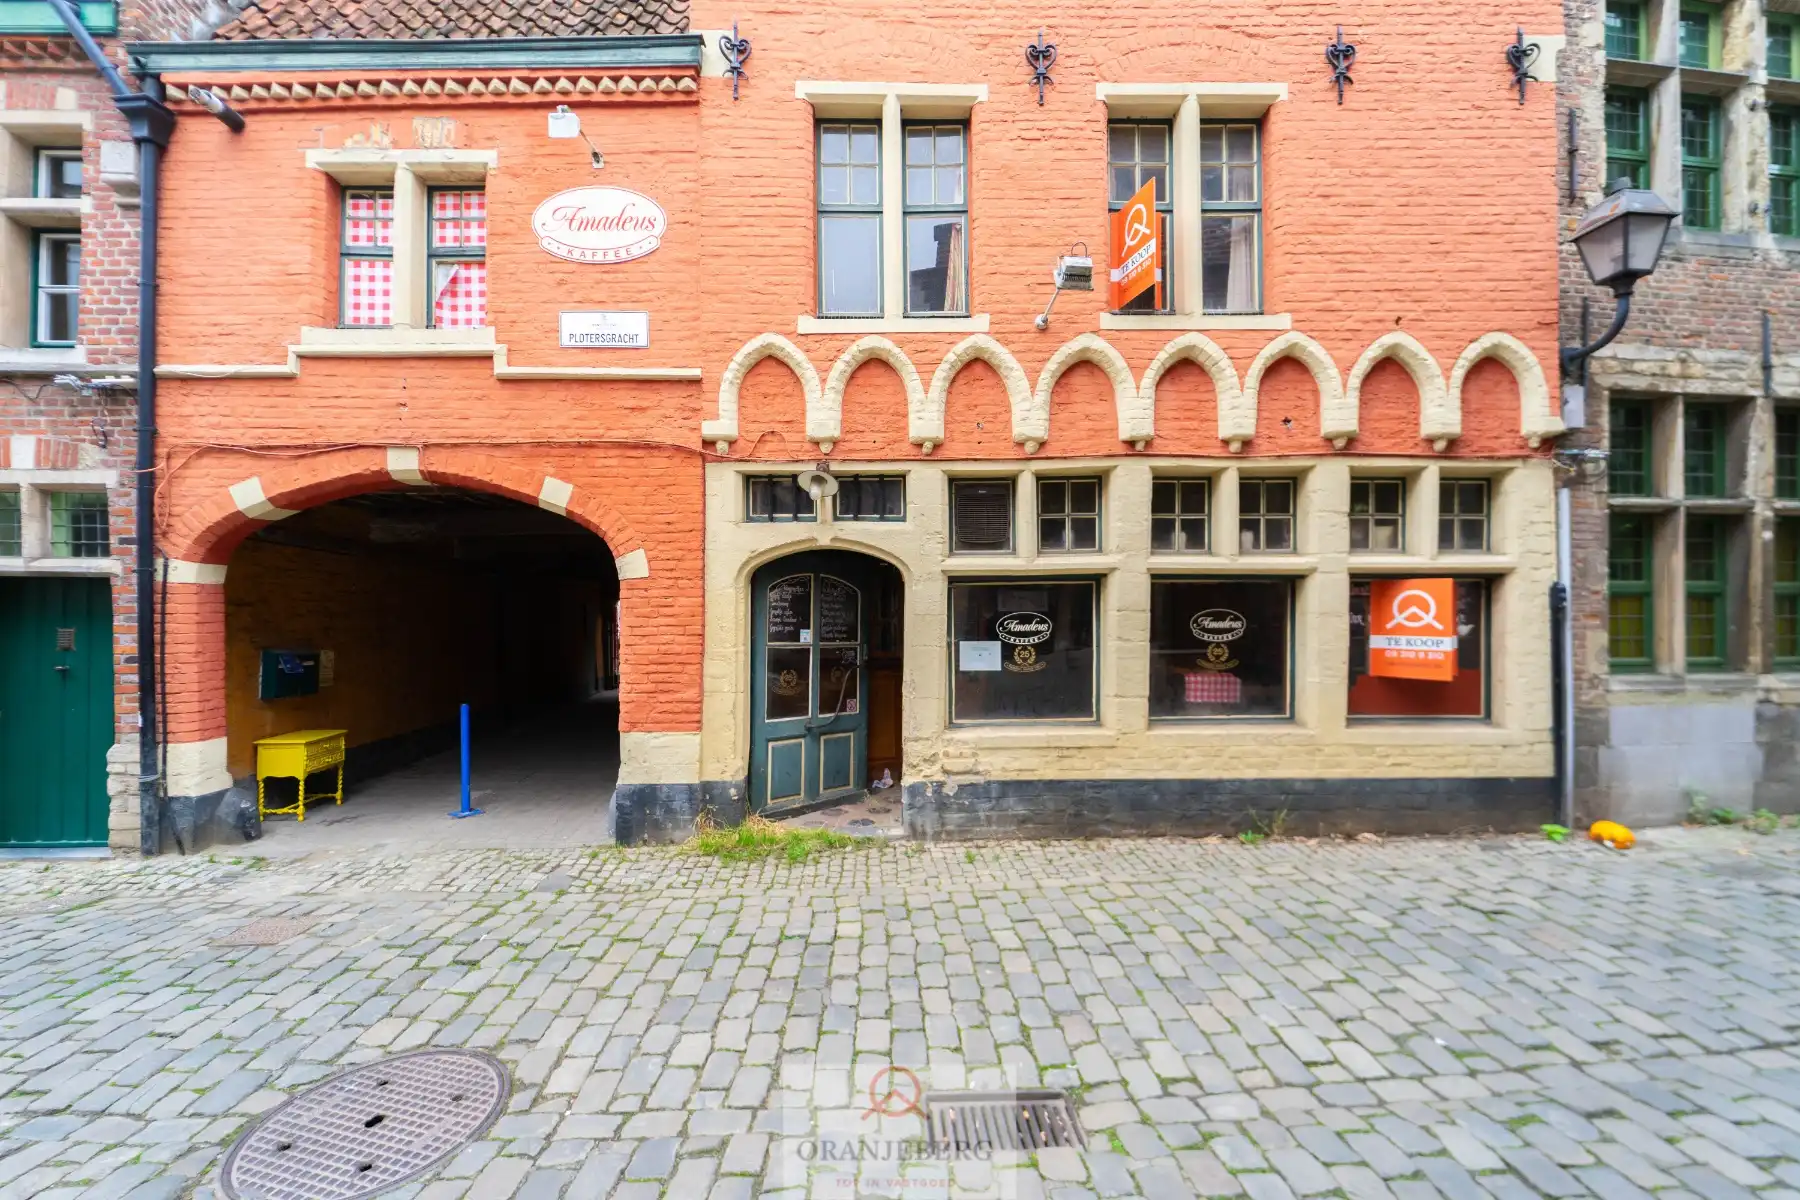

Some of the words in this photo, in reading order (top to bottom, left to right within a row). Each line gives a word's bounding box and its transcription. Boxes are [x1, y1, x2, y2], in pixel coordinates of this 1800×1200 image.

[541, 203, 657, 232] Amadeus
[566, 248, 633, 260] KAFFEE
[1122, 261, 1131, 274] TE
[1131, 244, 1151, 267] KOOP
[569, 333, 639, 344] PLOTERSGRACHT
[999, 618, 1049, 632] Amadeus
[1193, 615, 1243, 629] Amadeus
[1010, 636, 1039, 644] KAFFEE
[1385, 636, 1403, 646] TE
[1405, 638, 1444, 648] KOOP
[1020, 650, 1030, 658] 25
